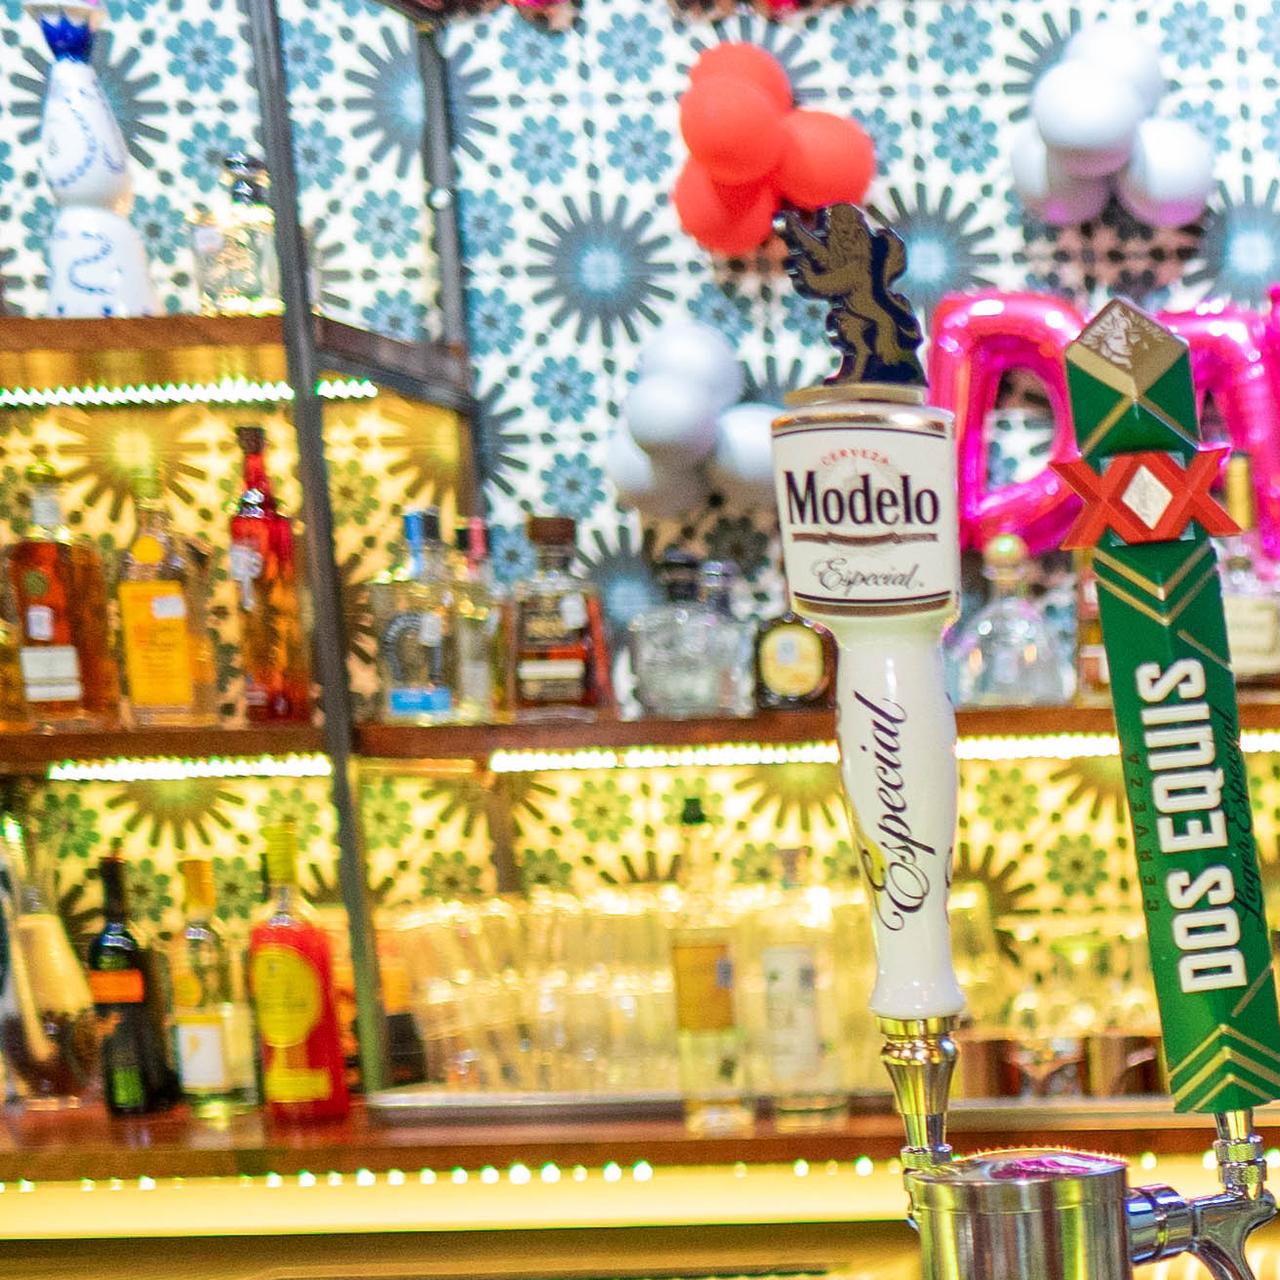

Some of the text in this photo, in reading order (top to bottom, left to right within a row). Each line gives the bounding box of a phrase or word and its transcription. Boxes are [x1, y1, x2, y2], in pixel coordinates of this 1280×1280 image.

[784, 470, 940, 526] Modelo
[820, 448, 890, 466] CERVEZA
[811, 556, 920, 597] Especial
[853, 690, 937, 932] Especial
[1127, 752, 1161, 912] CERVEZA
[1135, 657, 1248, 994] DOS EQUIS
